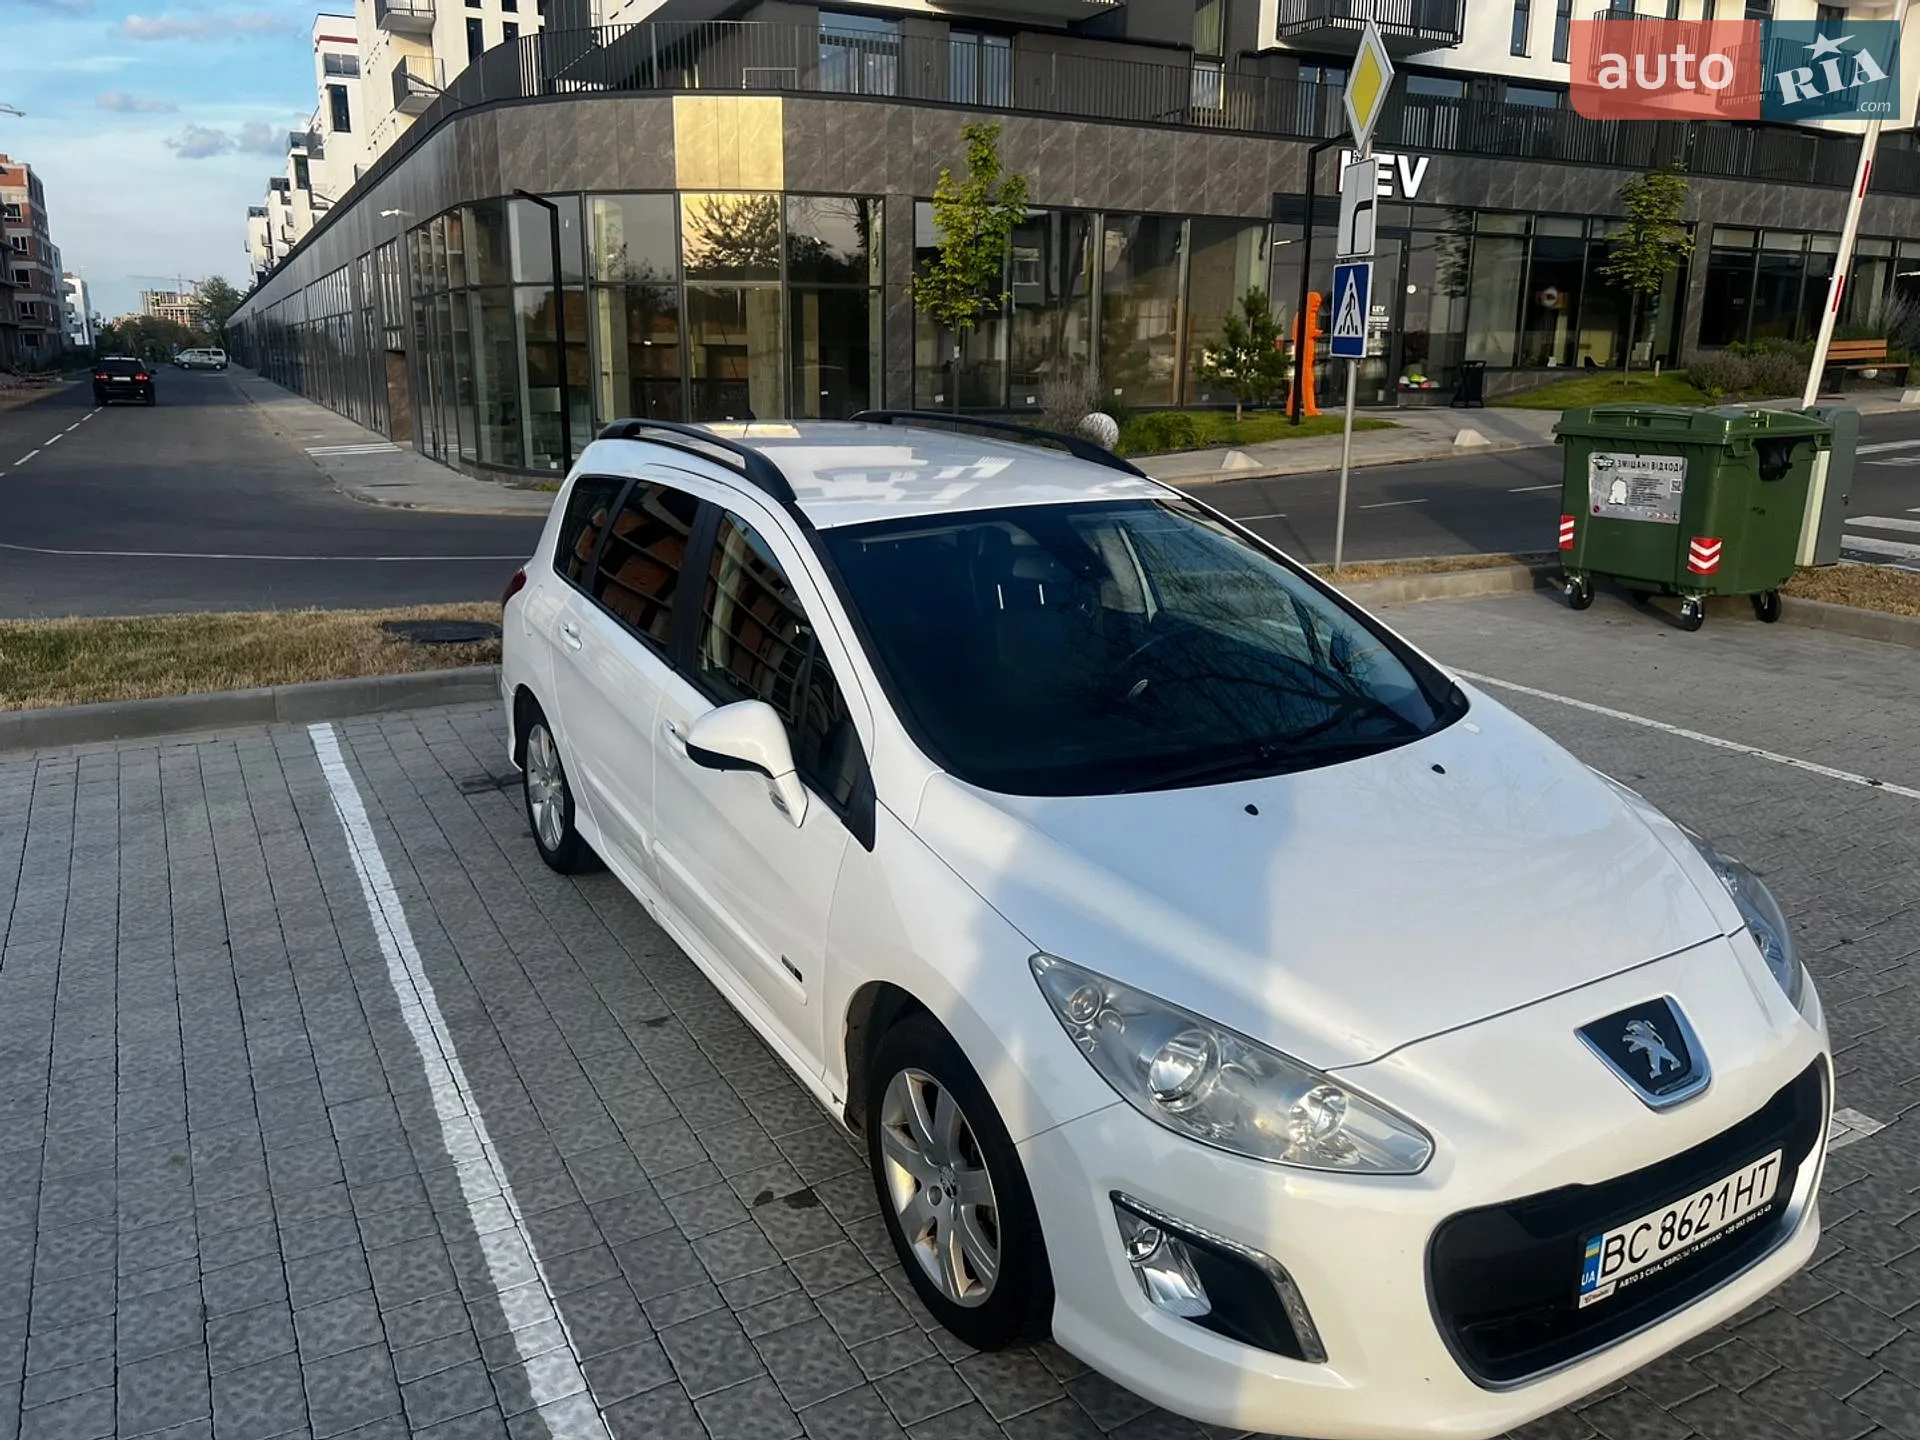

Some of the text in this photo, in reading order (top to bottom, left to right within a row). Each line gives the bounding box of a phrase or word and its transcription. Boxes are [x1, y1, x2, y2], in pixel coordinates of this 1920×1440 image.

[1600, 1157, 1777, 1278] BC 8621 HT
[1581, 1271, 1596, 1286] UA
